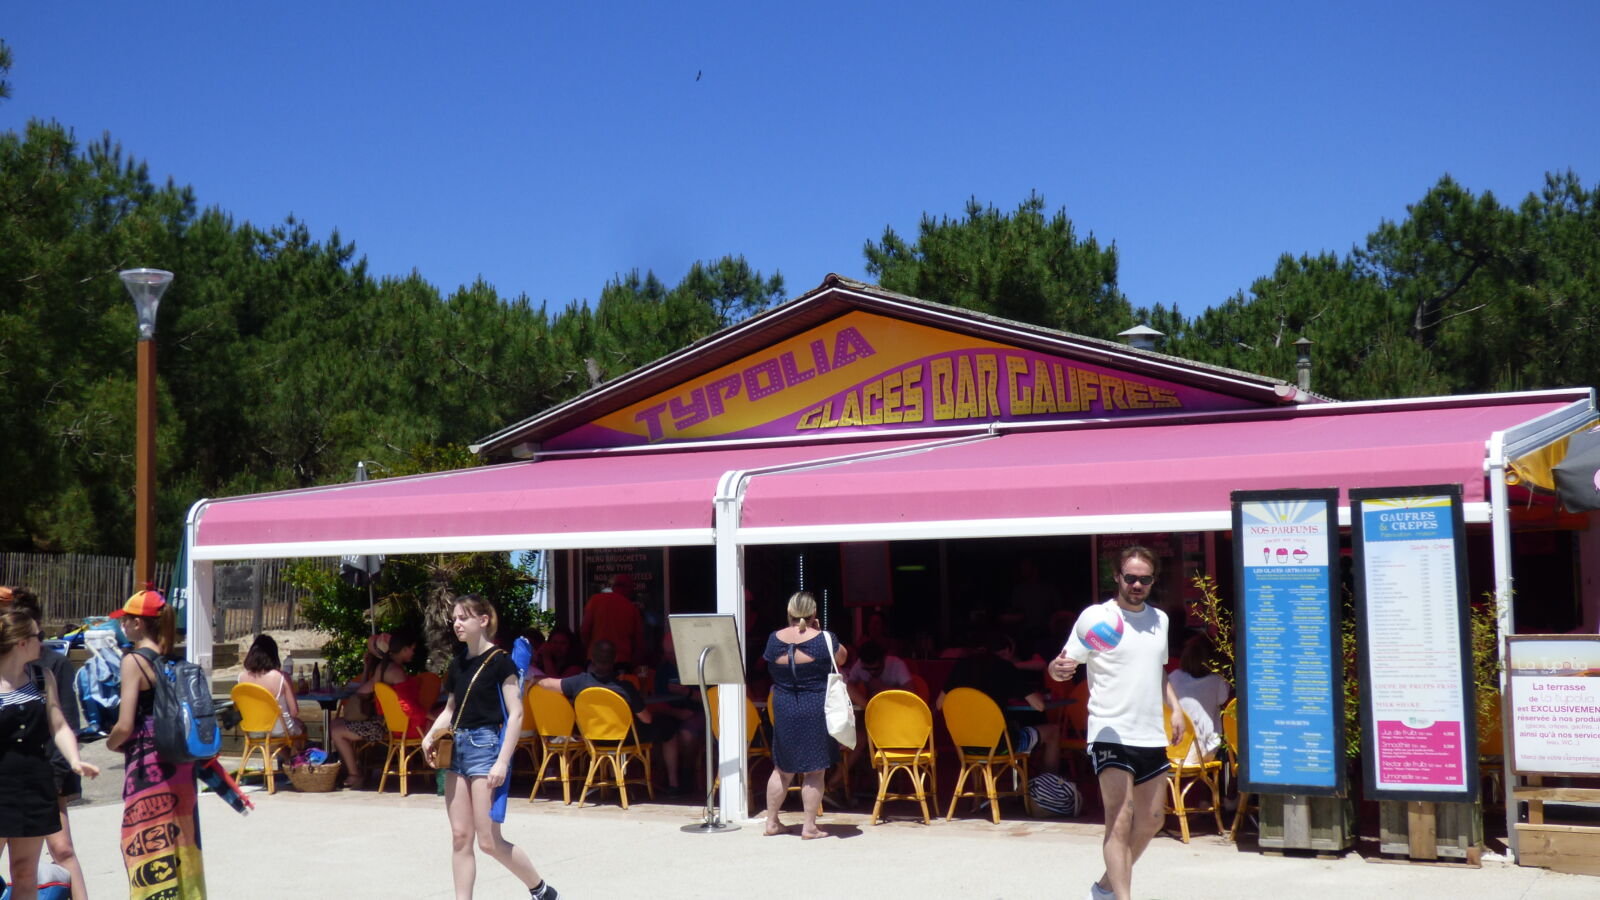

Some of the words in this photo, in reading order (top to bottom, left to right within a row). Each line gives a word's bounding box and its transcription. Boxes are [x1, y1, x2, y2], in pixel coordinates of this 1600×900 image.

[634, 326, 876, 443] TYPOLIA
[795, 364, 925, 430] GLACES
[930, 353, 1001, 419] BAR
[1006, 355, 1183, 417] GAUFRES
[1379, 511, 1436, 522] GAUFRES
[1250, 526, 1270, 535] NOS
[1271, 525, 1319, 535] PARFUMS
[1532, 683, 1544, 691] La
[1546, 683, 1586, 691] terrasse
